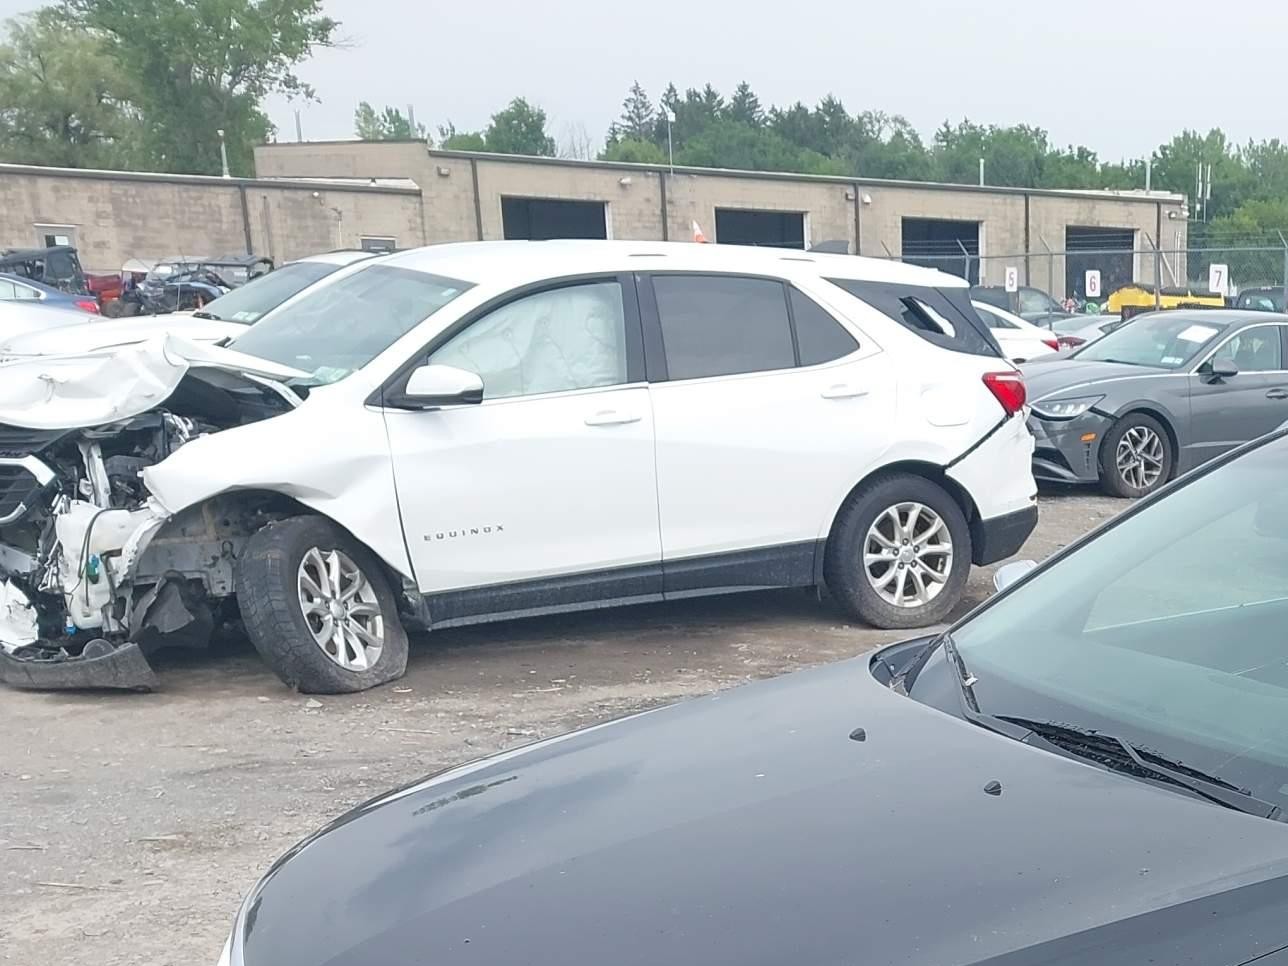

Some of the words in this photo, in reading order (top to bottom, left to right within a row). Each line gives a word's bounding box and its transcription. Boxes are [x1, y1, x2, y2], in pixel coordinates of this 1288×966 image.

[1008, 271, 1015, 287] 5
[1089, 278, 1097, 292] 6
[1214, 270, 1223, 288] 7
[423, 524, 504, 541] EQUINOX
